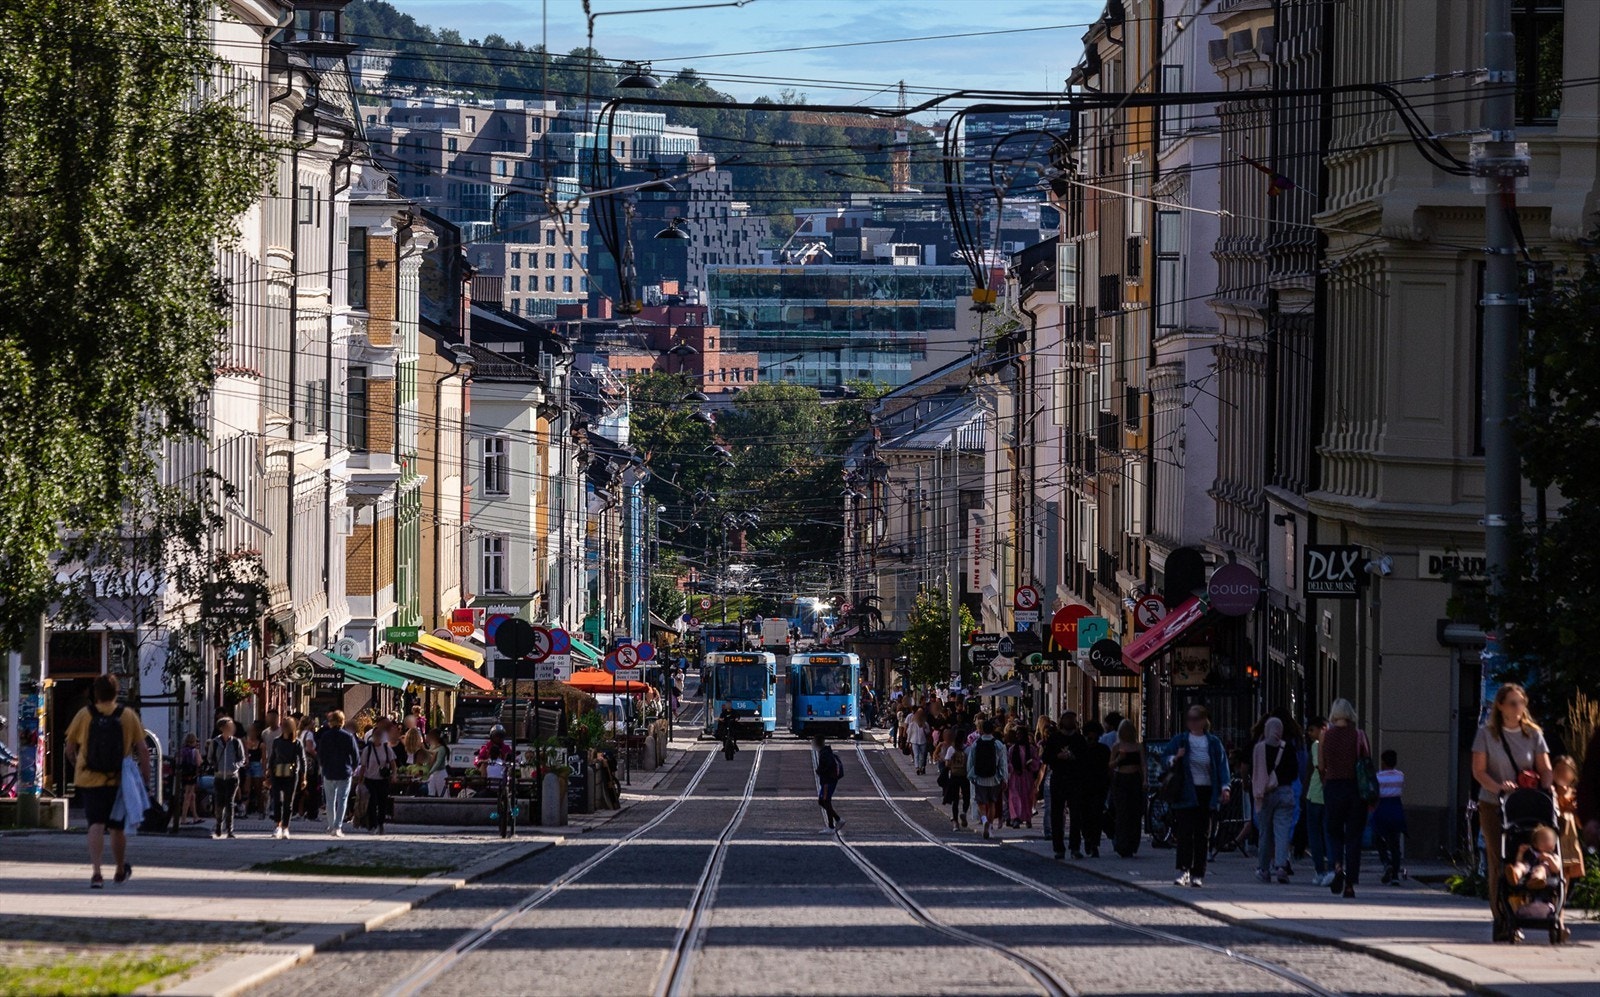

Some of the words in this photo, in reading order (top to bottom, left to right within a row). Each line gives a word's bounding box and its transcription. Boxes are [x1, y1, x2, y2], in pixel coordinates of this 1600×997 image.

[1308, 550, 1359, 581] DLX
[1429, 555, 1486, 574] DELUX
[1209, 584, 1259, 595] COUCH
[1308, 581, 1334, 590] DELUXE
[1335, 581, 1356, 591] MUSIC
[1055, 623, 1077, 632] EXT
